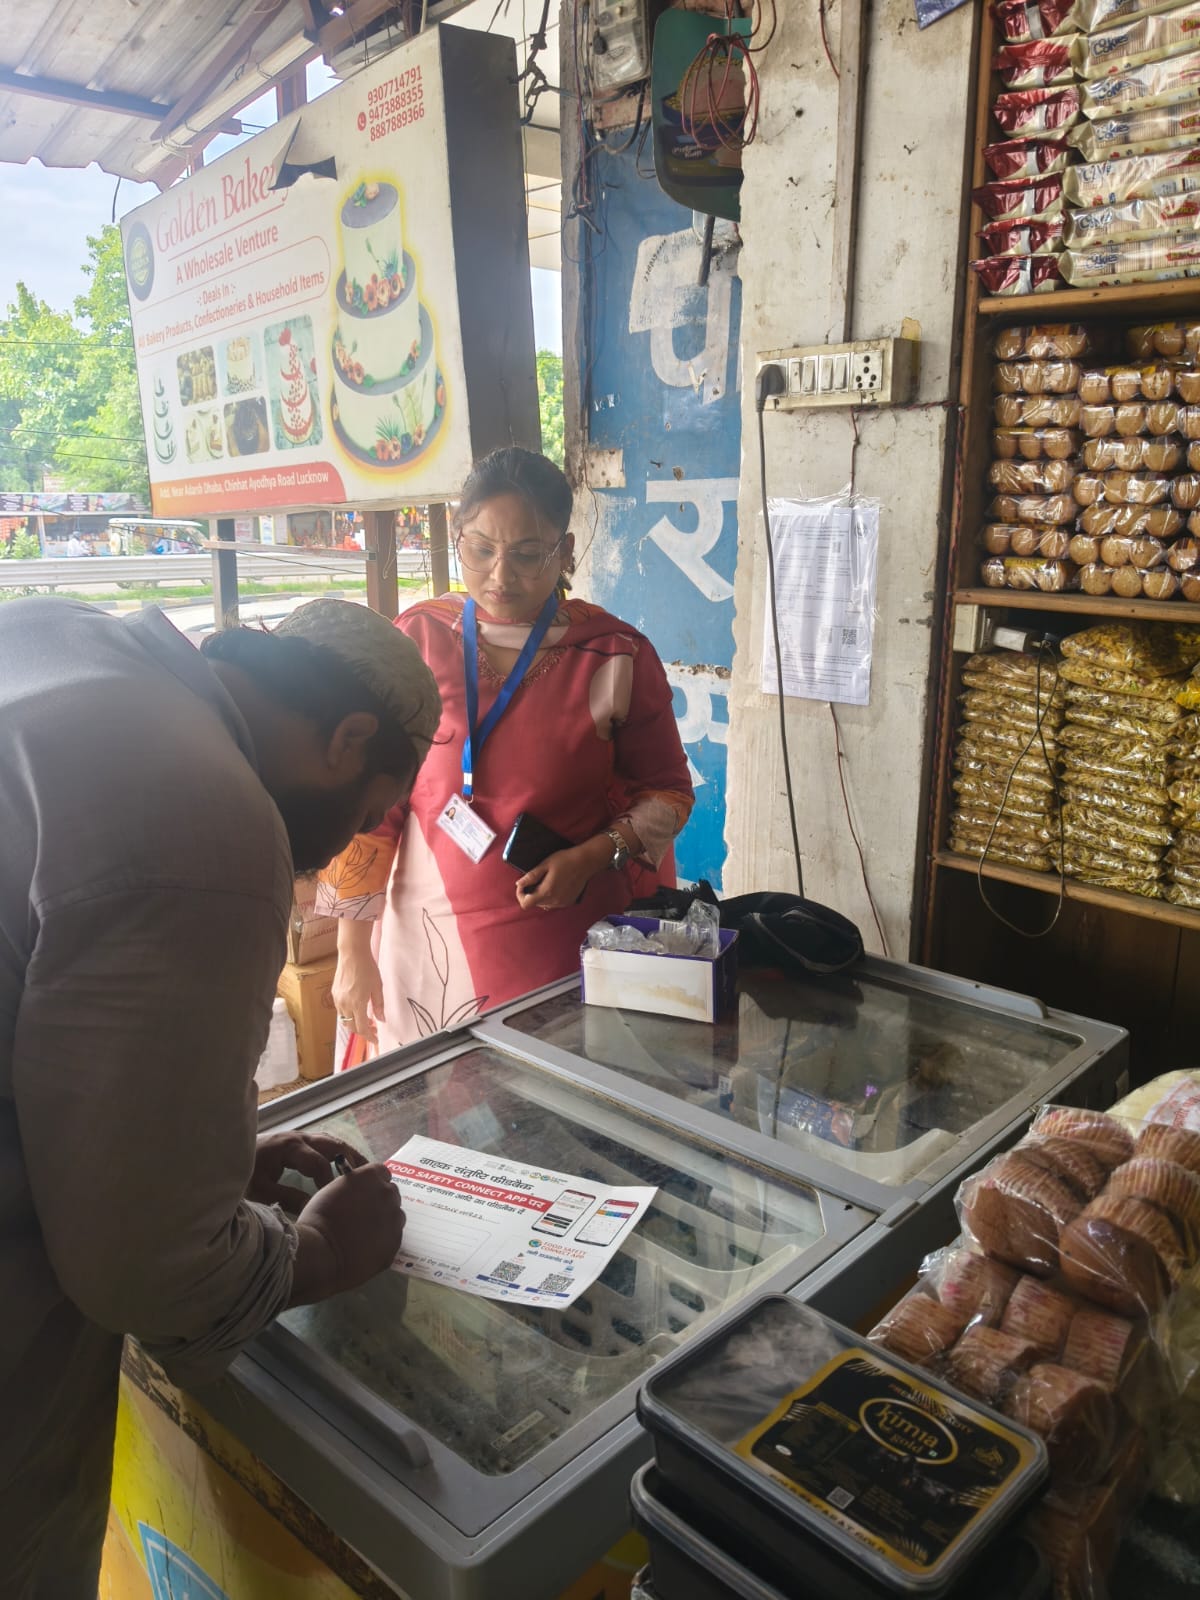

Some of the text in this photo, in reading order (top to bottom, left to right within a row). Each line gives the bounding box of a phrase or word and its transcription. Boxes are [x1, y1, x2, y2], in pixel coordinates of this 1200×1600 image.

[367, 65, 422, 106] 9307714791
[369, 84, 424, 124] 9473888355
[370, 102, 425, 142] 8887889366
[156, 192, 218, 253] Golden
[176, 266, 183, 285] A
[184, 243, 234, 282] Wholesale
[234, 224, 279, 259] Venture
[146, 330, 165, 347] Bakery
[166, 320, 195, 338] Products,
[194, 300, 246, 328] Confectioneries
[247, 293, 255, 310] &
[255, 279, 298, 306] Household
[300, 271, 325, 290] Items
[203, 286, 221, 305] Deals
[224, 478, 248, 492] Chinhat
[249, 475, 277, 492] Ayodhya
[278, 472, 295, 486] Road
[297, 470, 328, 485] Lucknow
[386, 1163, 546, 1209] FOOD SAFETY CONNECT APP पर
[420, 1157, 452, 1171] ग्राहक
[454, 1165, 489, 1180] संतुष्टि
[490, 1173, 535, 1191] फीडबैक
